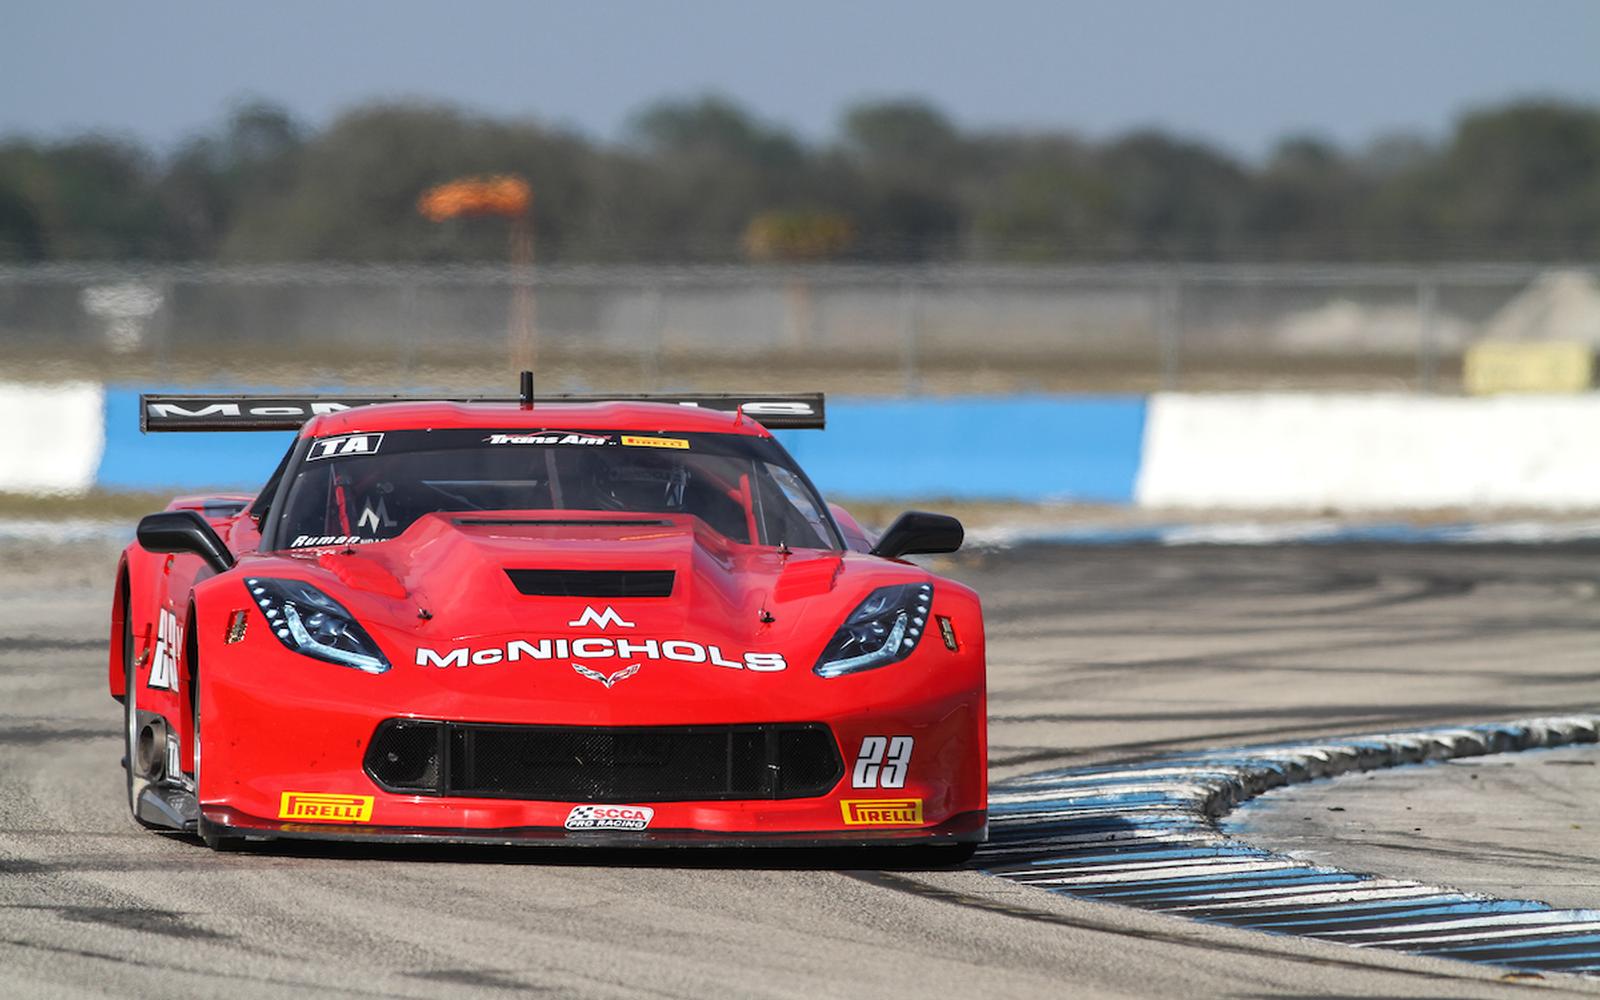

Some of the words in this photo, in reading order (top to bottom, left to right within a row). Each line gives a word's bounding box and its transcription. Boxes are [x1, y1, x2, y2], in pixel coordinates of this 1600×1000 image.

[321, 436, 369, 455] TA
[489, 435, 560, 445] Trans
[558, 434, 606, 446] Am
[415, 638, 788, 672] McNICHOLS
[851, 735, 914, 789] 23
[287, 796, 365, 818] PIRELLI
[593, 808, 646, 820] SCCA
[848, 801, 917, 822] PIRELLI
[568, 820, 595, 828] PRO
[596, 819, 644, 829] RACING
